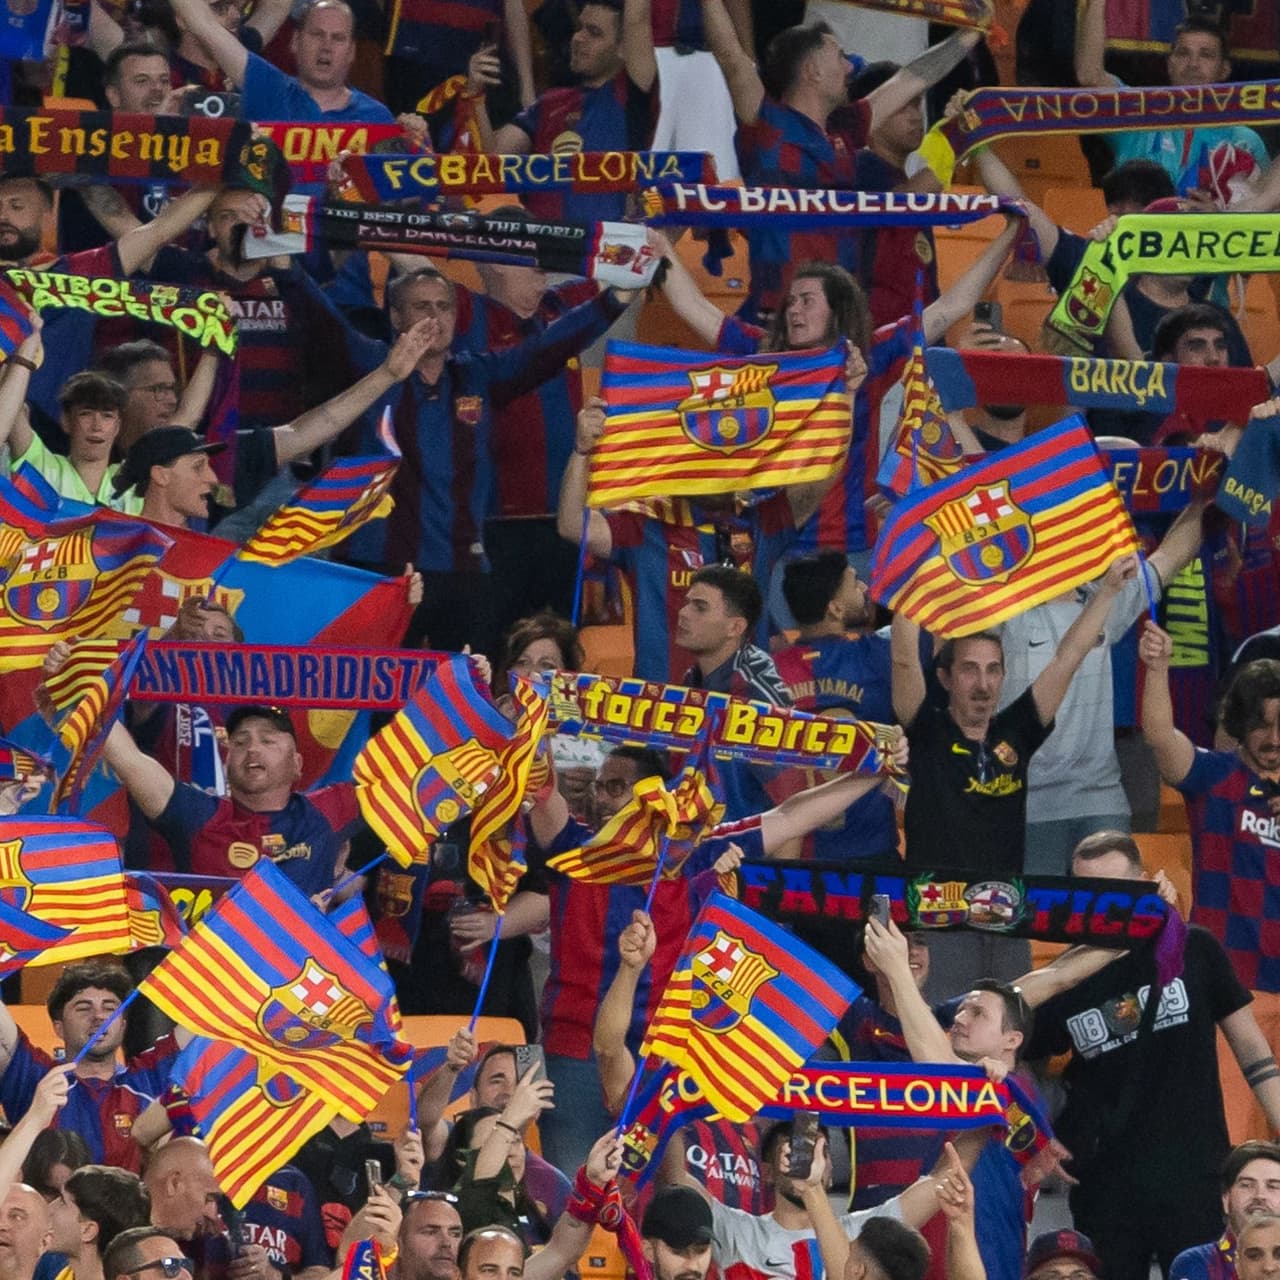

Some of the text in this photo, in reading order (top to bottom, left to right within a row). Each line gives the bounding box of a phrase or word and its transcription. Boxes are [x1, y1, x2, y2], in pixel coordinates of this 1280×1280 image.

[24, 116, 222, 171] Ensenya
[383, 152, 685, 191] FCBARCELONA
[675, 184, 1000, 213] FC BARCELONA
[362, 210, 402, 224] BEST
[526, 223, 586, 239] WORLD
[1071, 357, 1167, 406] BARÇA
[30, 567, 68, 582] FCB
[701, 971, 733, 1002] FCB
[297, 1006, 331, 1030] FCB
[686, 1145, 761, 1178] QATAR
